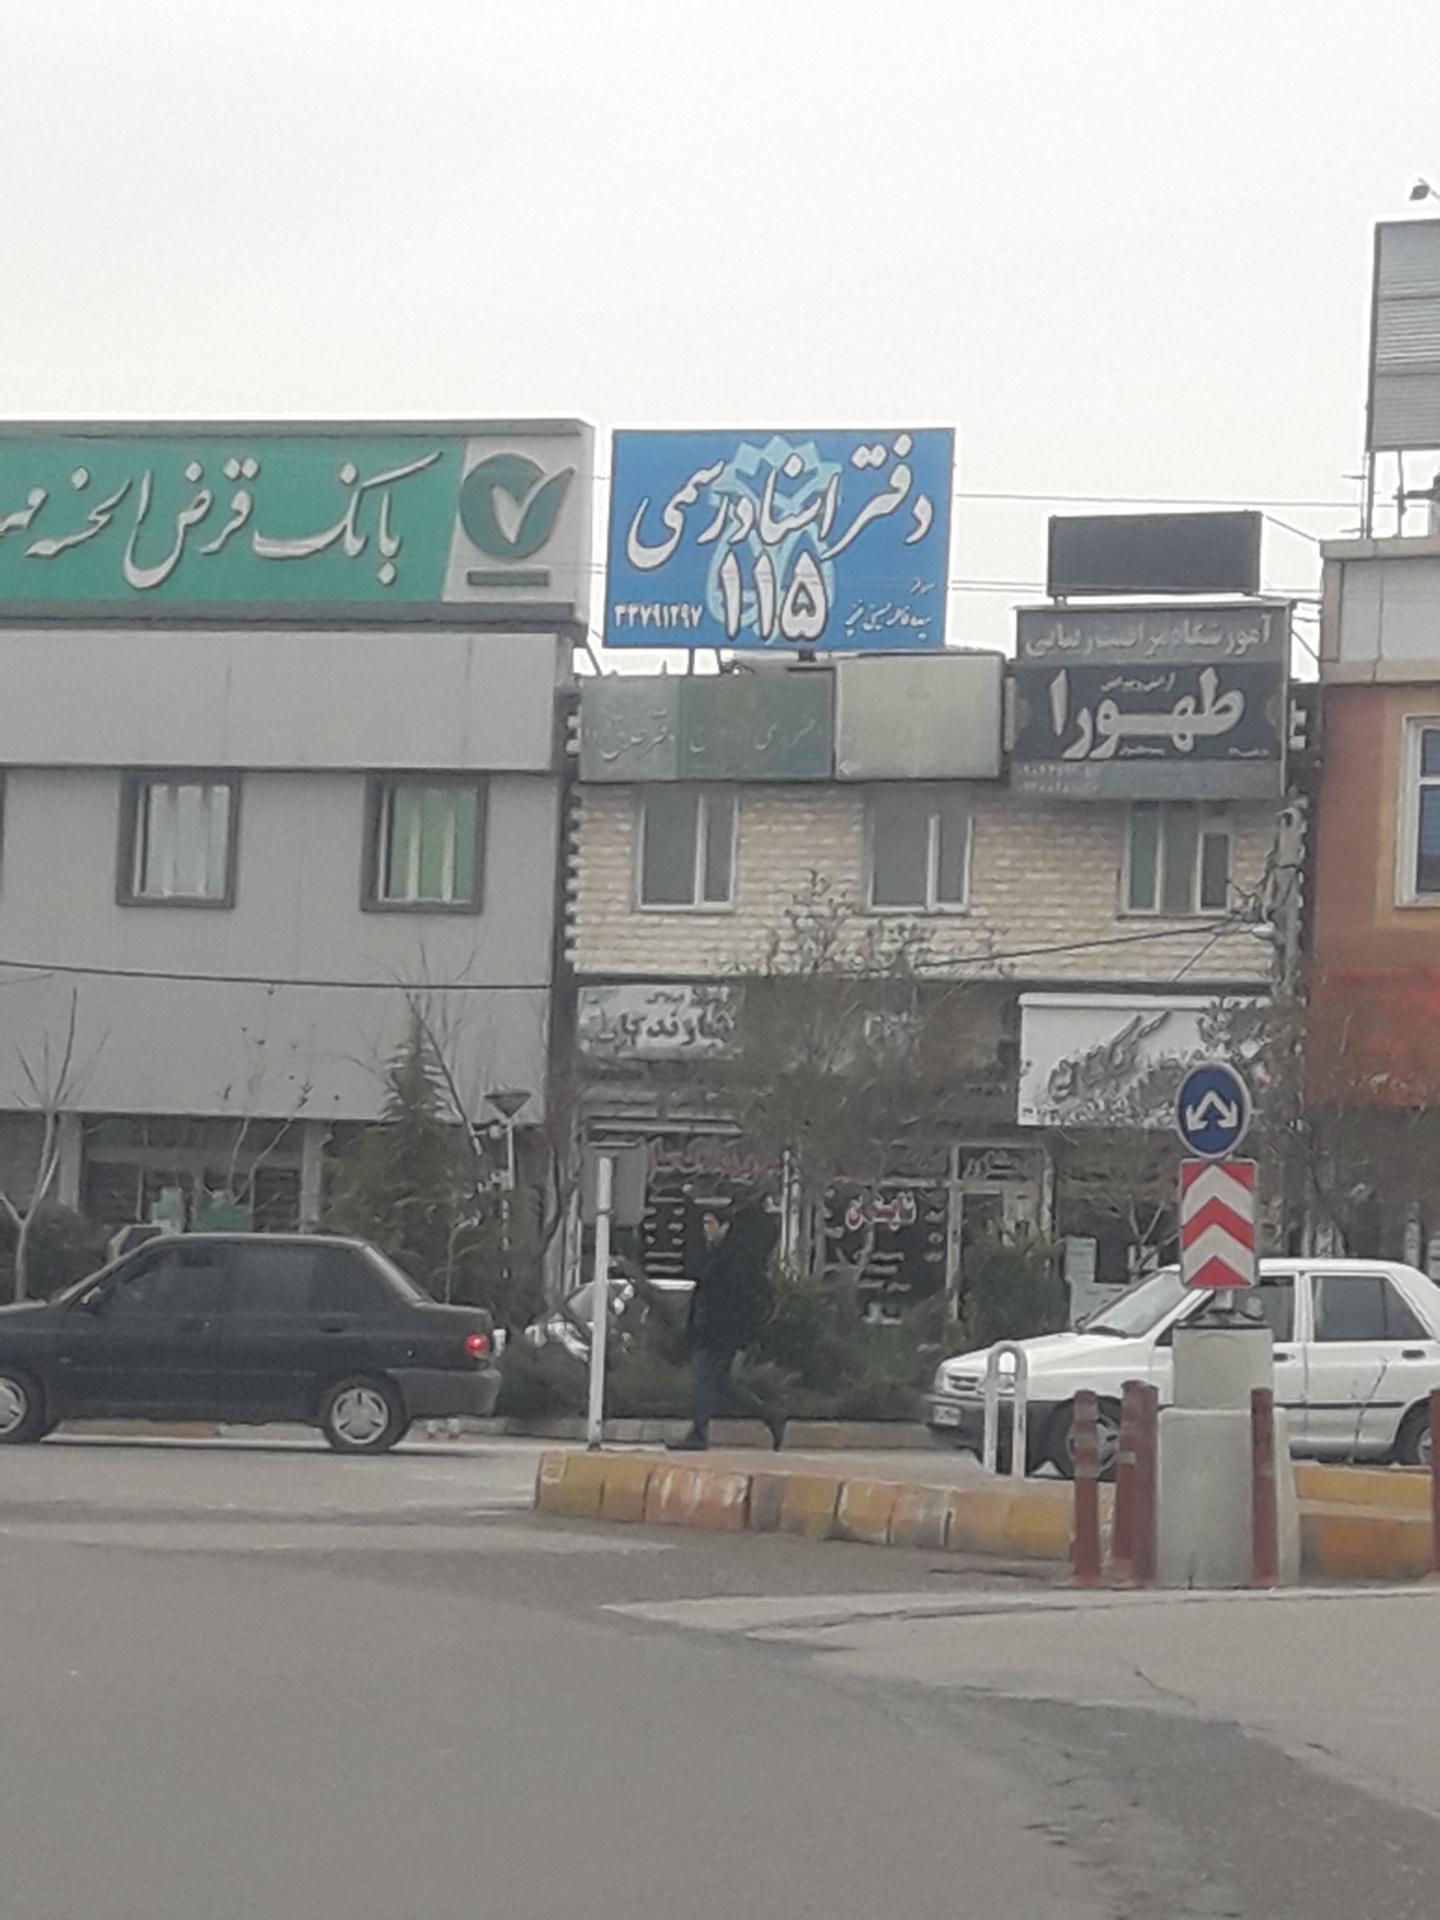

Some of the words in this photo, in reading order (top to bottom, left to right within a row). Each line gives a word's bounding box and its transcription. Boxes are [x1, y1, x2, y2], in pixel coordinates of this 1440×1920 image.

[122, 457, 260, 588] قرض
[252, 450, 443, 587] بانک
[626, 459, 728, 571] رسمی
[729, 453, 841, 546] اسناد
[819, 432, 934, 562] دفتر
[720, 550, 828, 641] ۱۱۵
[1050, 666, 1246, 760] طهورا
